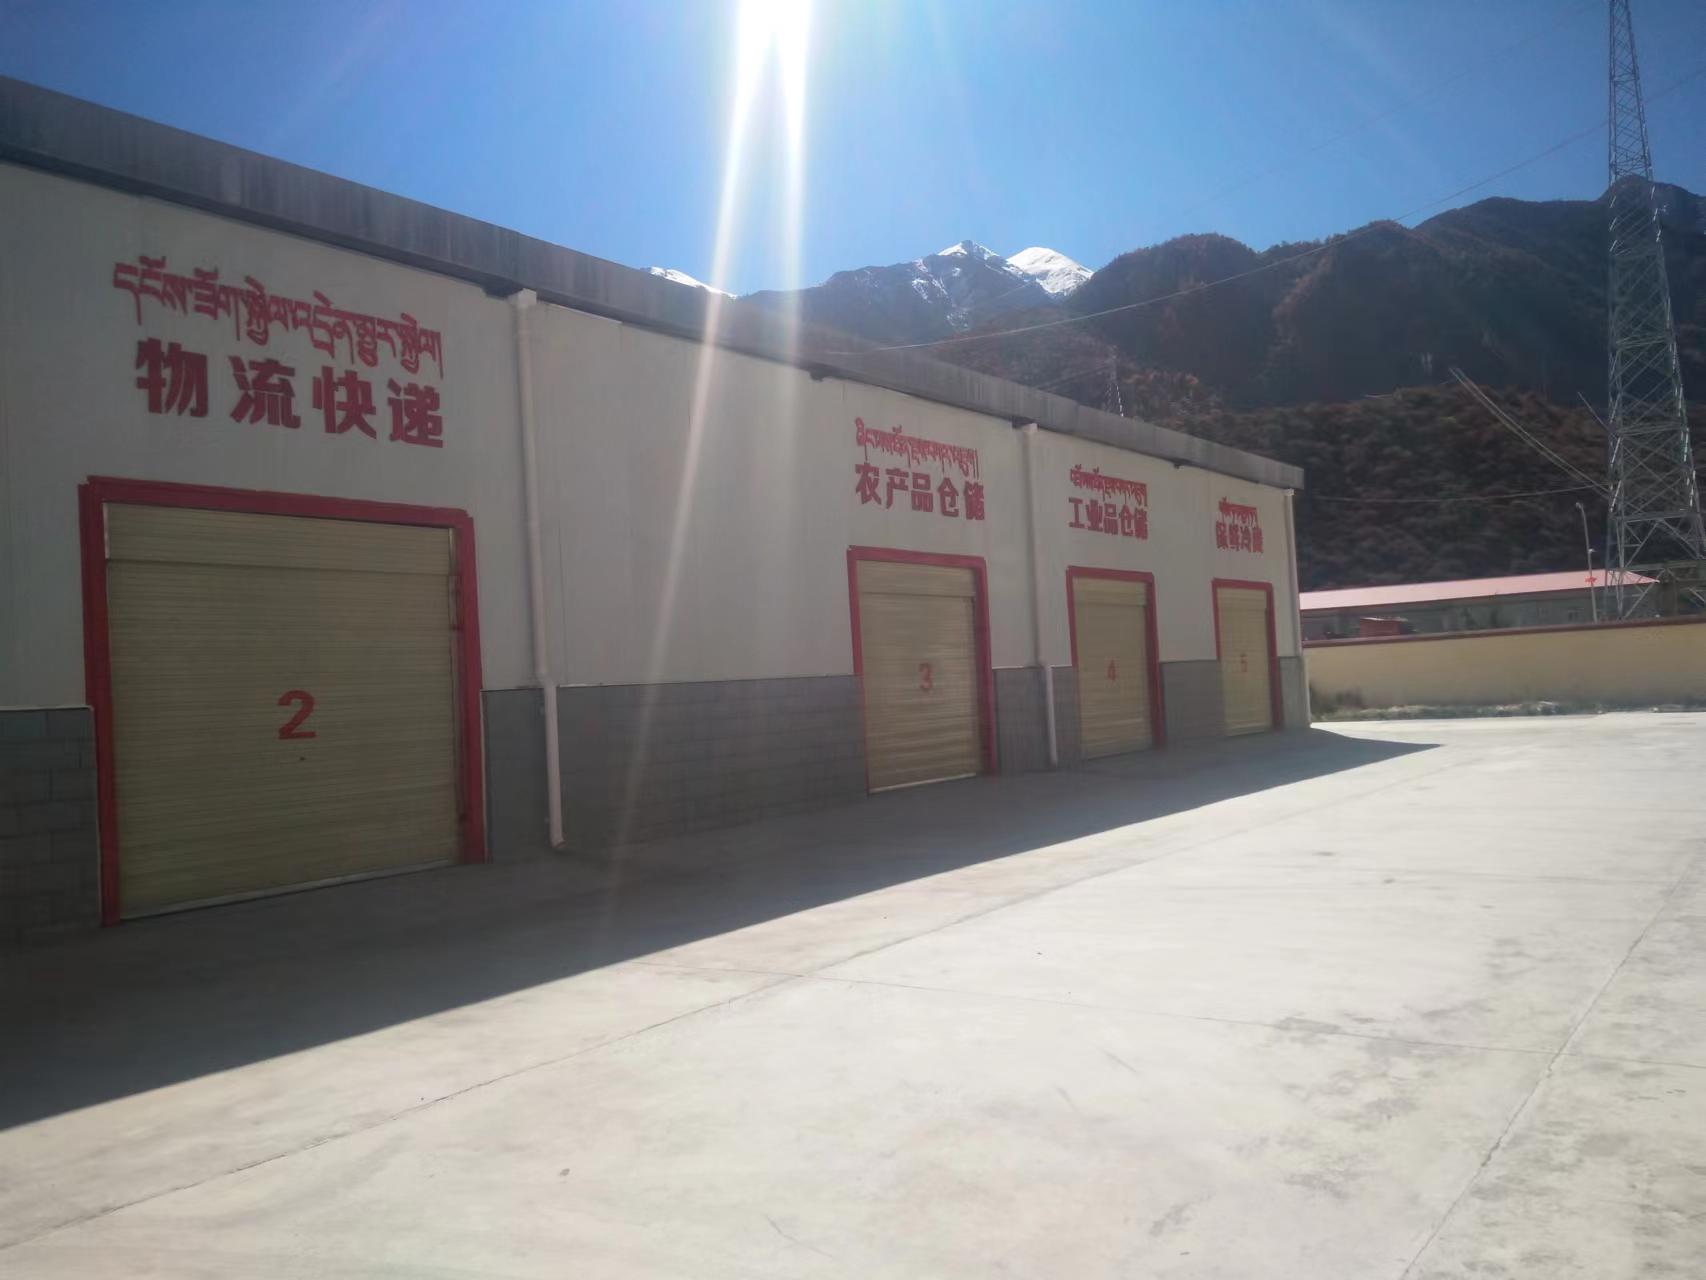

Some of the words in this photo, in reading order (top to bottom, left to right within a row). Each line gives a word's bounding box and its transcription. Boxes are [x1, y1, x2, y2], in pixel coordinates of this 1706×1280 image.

[136, 337, 444, 448] 物流快递
[855, 462, 985, 520] 农产品仓储
[1069, 497, 1148, 539] 工业品仓储
[919, 662, 933, 692] 3
[278, 690, 316, 739] 2
